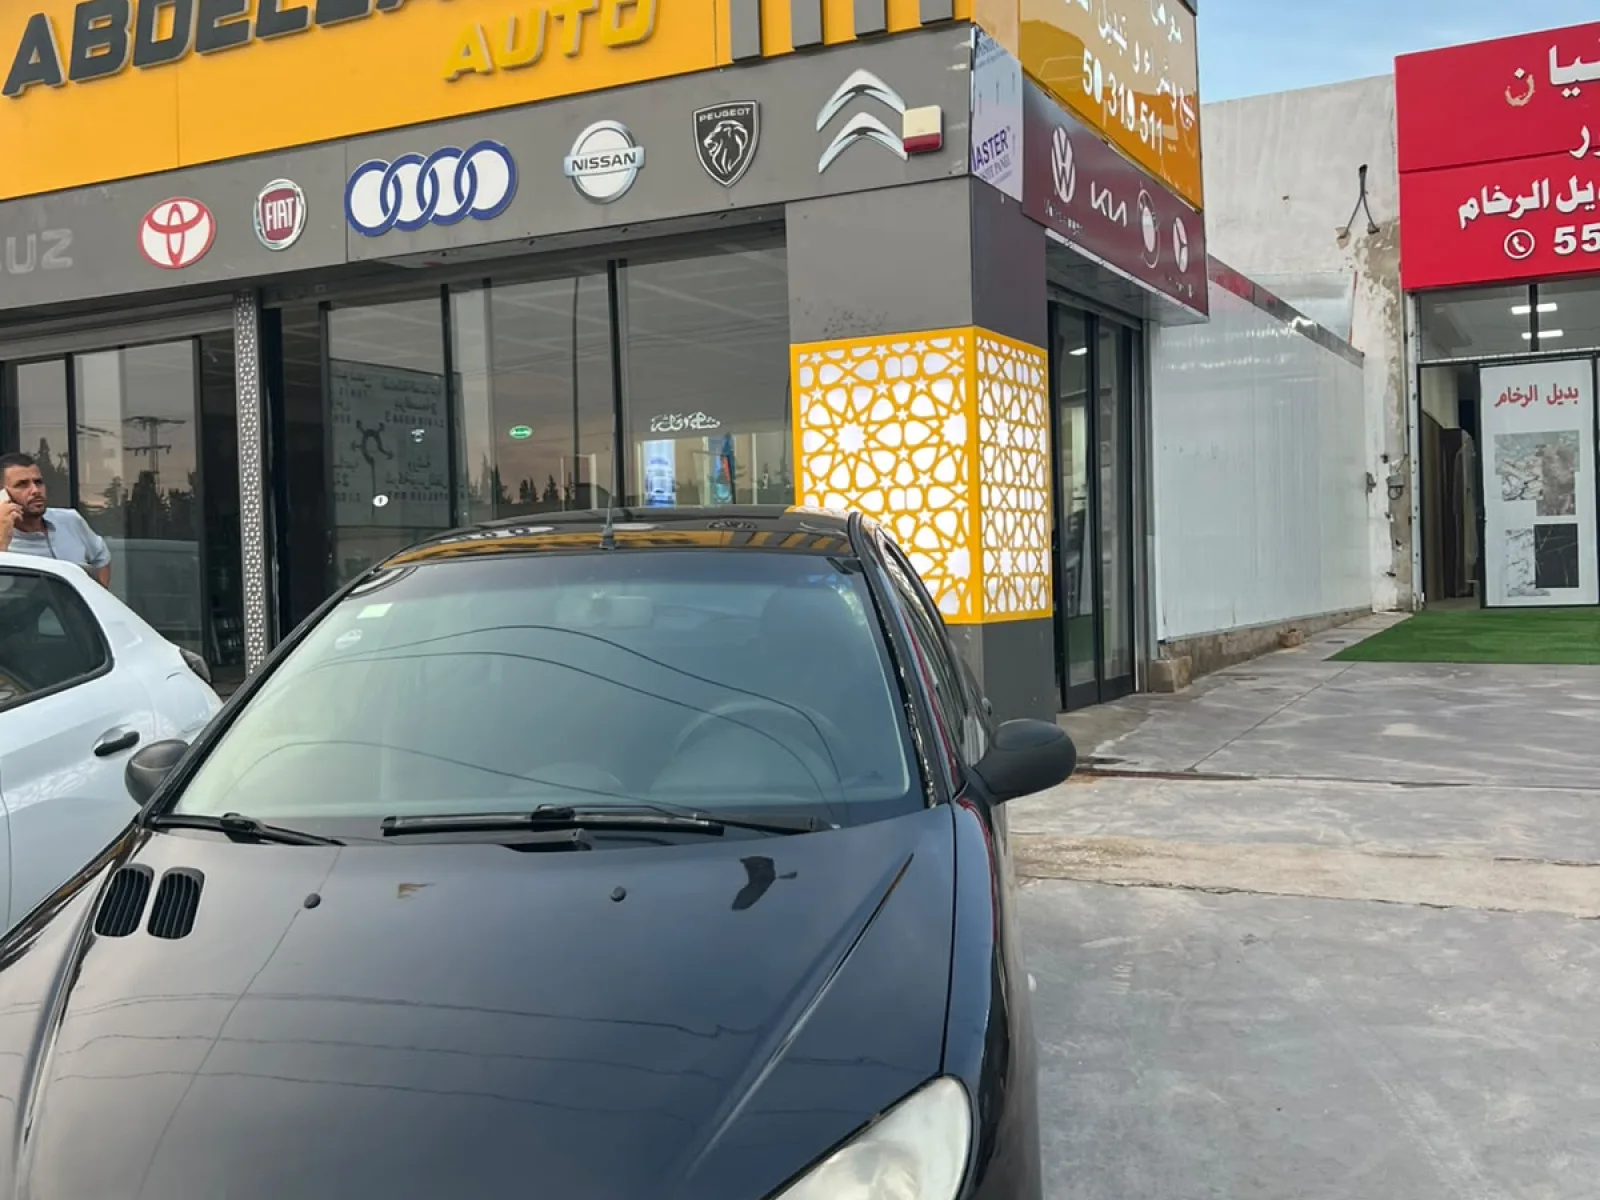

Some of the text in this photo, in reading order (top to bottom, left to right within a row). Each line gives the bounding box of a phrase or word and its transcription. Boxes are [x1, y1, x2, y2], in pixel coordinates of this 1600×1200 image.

[441, 0, 660, 82] AUTO
[699, 106, 752, 124] PEUGEOT
[1082, 47, 1163, 157] 50 319 511
[571, 151, 637, 173] NISSAN
[265, 197, 294, 232] FIAT
[1458, 176, 1550, 230] الرخام
[1494, 383, 1580, 408] بديل الرخام
